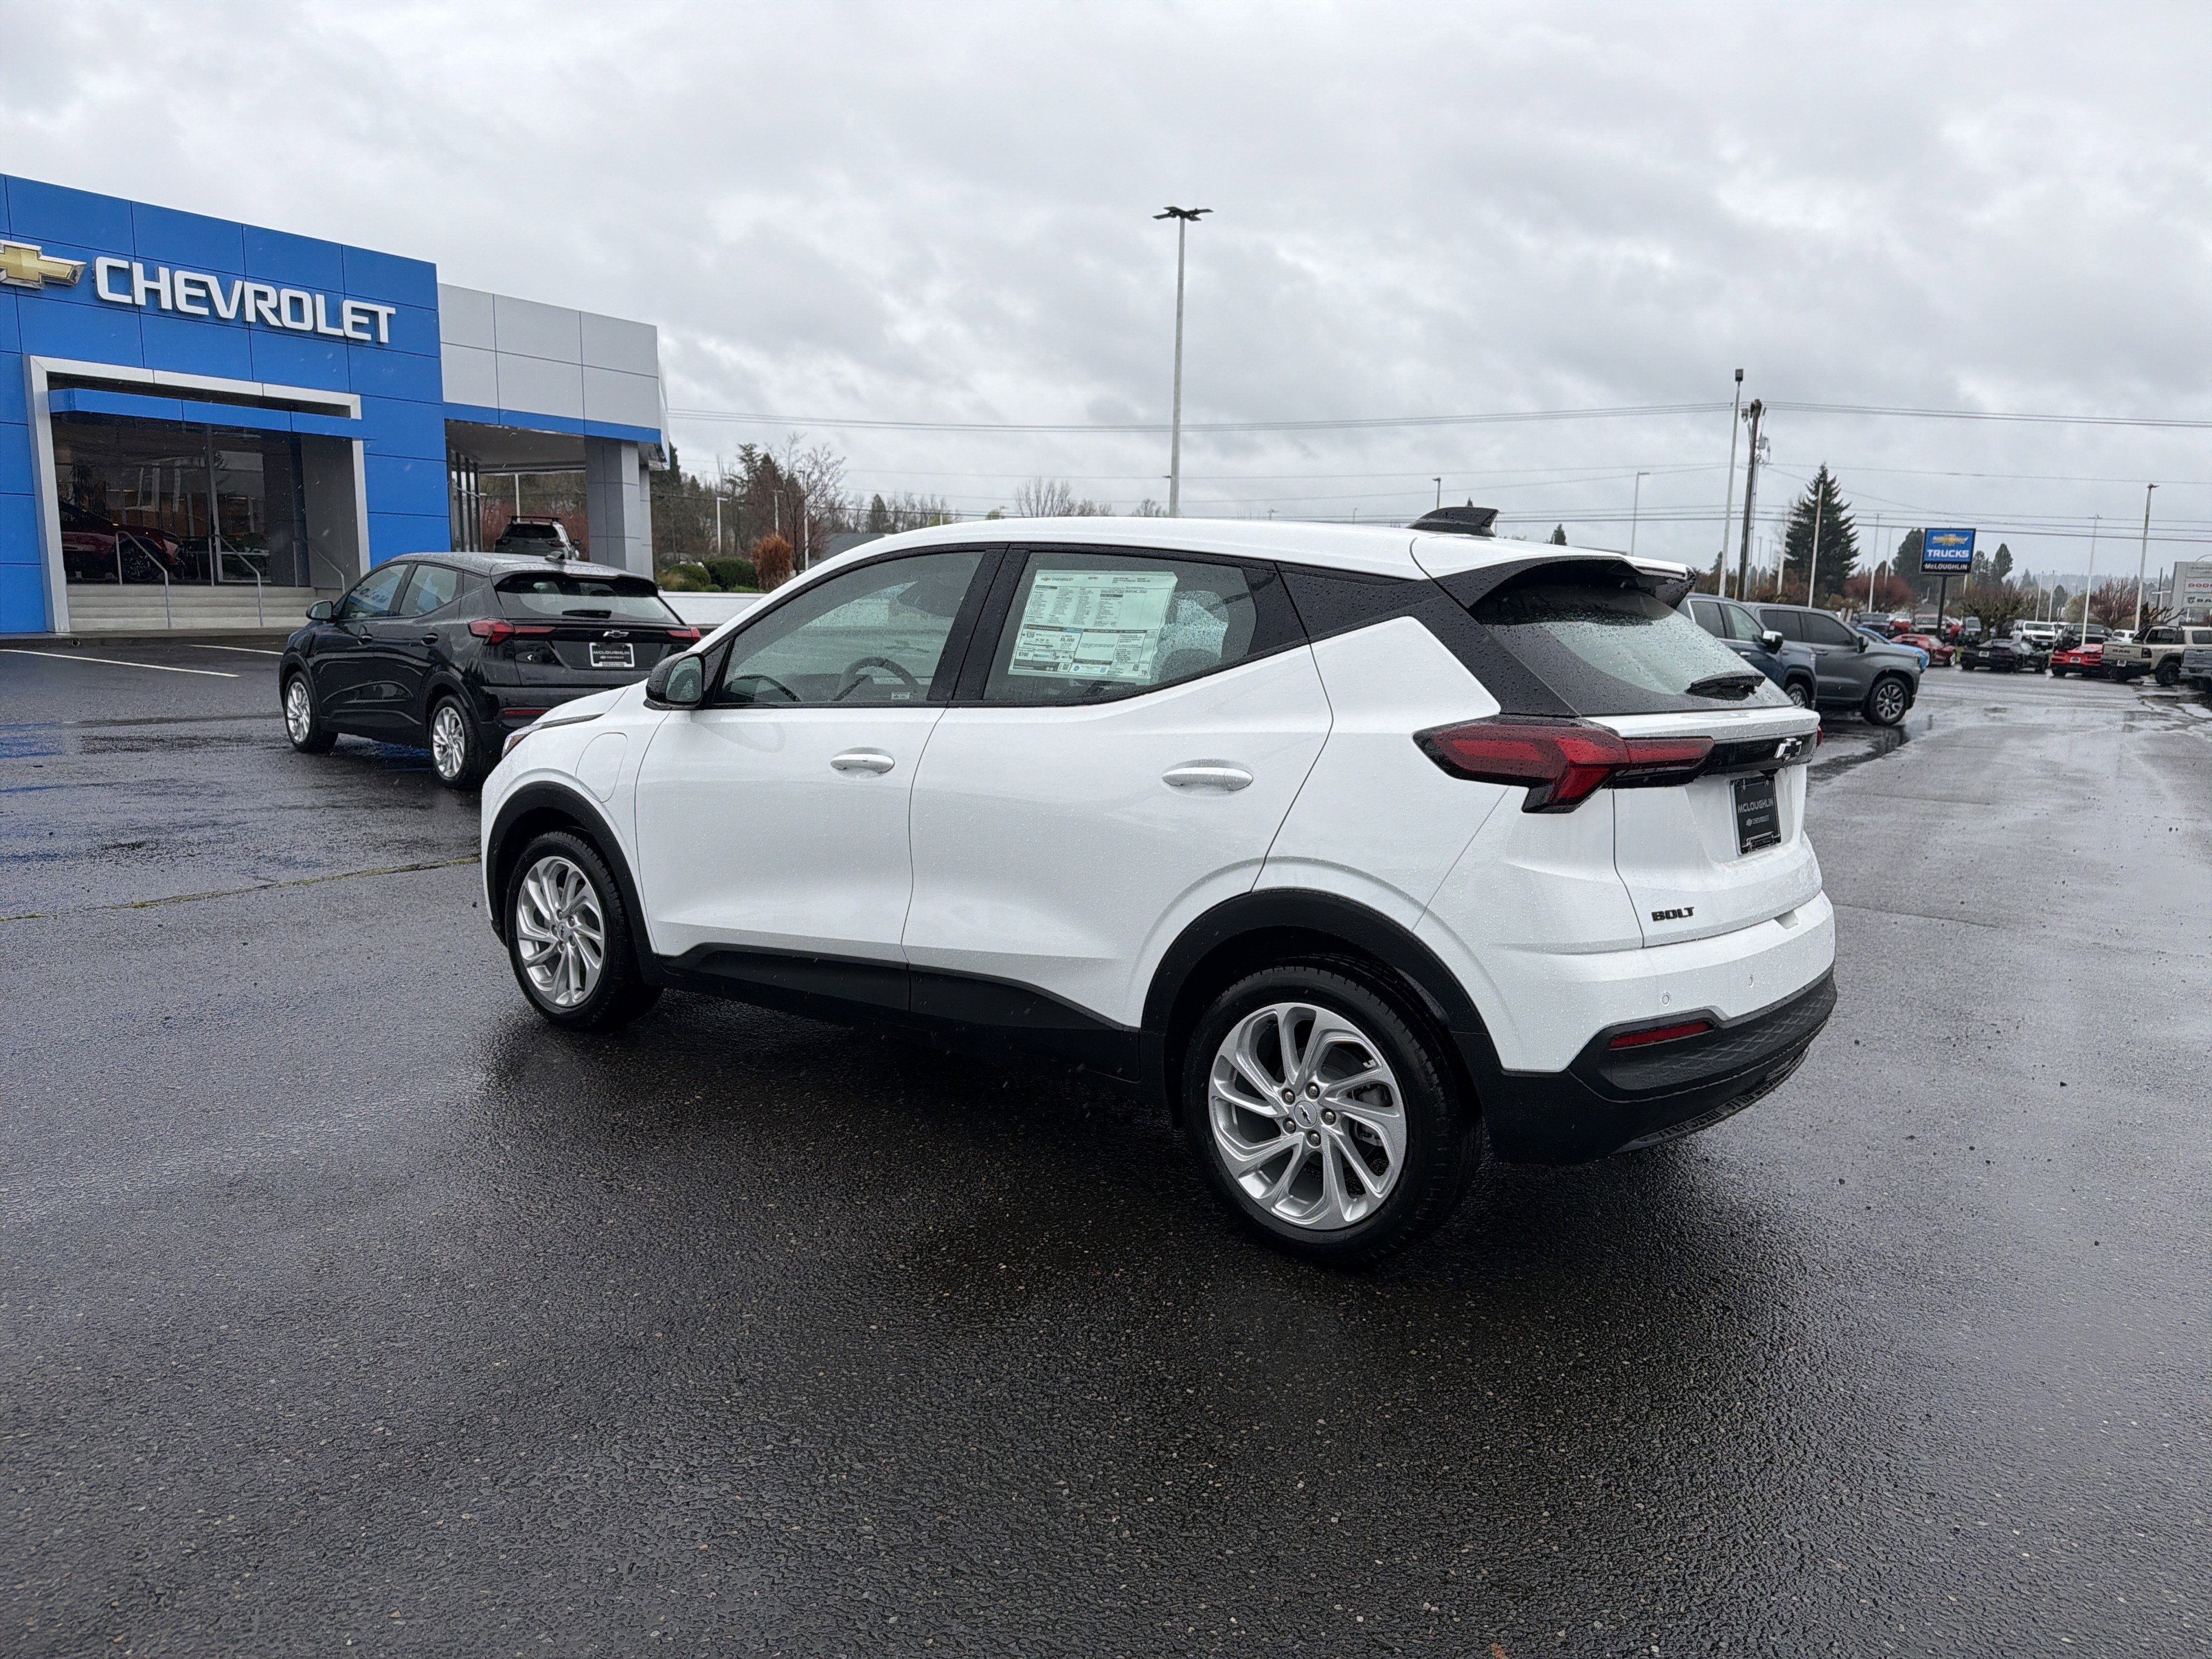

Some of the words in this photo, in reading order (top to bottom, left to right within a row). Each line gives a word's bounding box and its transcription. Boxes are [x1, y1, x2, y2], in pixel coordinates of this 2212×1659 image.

[95, 256, 396, 343] CHEVROLET
[1926, 549, 1970, 557] TRUCKS
[1737, 798, 1774, 814] MCLOUGHLIN
[1651, 906, 1695, 922] BOLT
